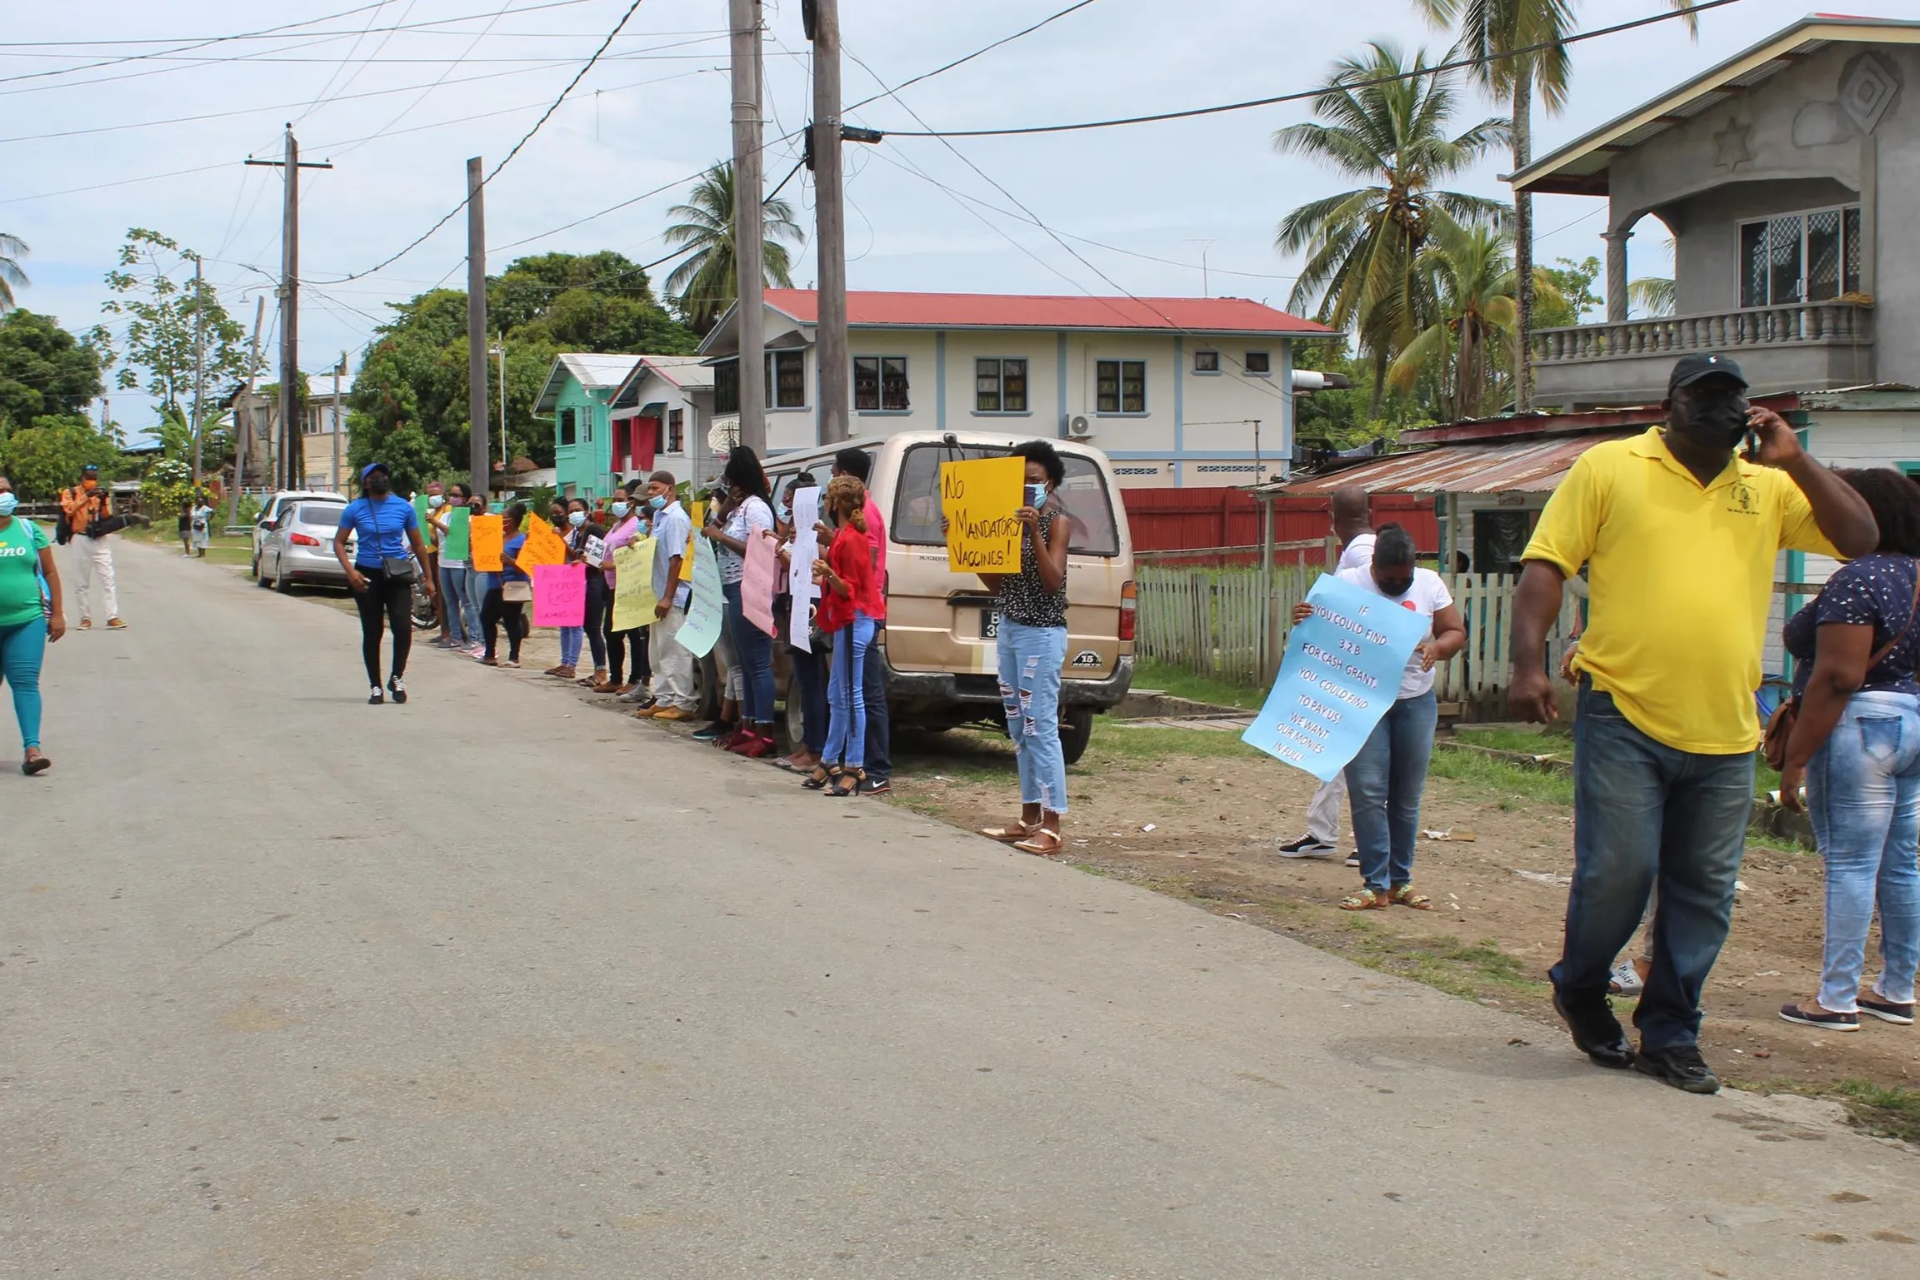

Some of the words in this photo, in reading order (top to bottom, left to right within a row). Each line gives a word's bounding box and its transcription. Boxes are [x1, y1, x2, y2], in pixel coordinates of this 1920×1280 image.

[955, 508, 1022, 540] MANDATORY
[1358, 605, 1369, 616] IF
[1314, 604, 1332, 620] YOU
[1334, 615, 1363, 634] COULD
[1365, 629, 1387, 646] FIND
[1302, 642, 1321, 658] FOR
[1322, 652, 1343, 669] CASH
[1339, 638, 1353, 652] 3.2
[1298, 667, 1319, 682] YOU
[1319, 679, 1348, 700] COULD
[1347, 693, 1369, 710] FIND
[1298, 694, 1311, 707] TO
[1311, 700, 1328, 715] PAY
[1276, 722, 1294, 738] OUR
[1293, 732, 1325, 754] MONIES
[1290, 712, 1304, 726] WE
[1304, 720, 1330, 739] WANT
[1272, 742, 1283, 752] IN
